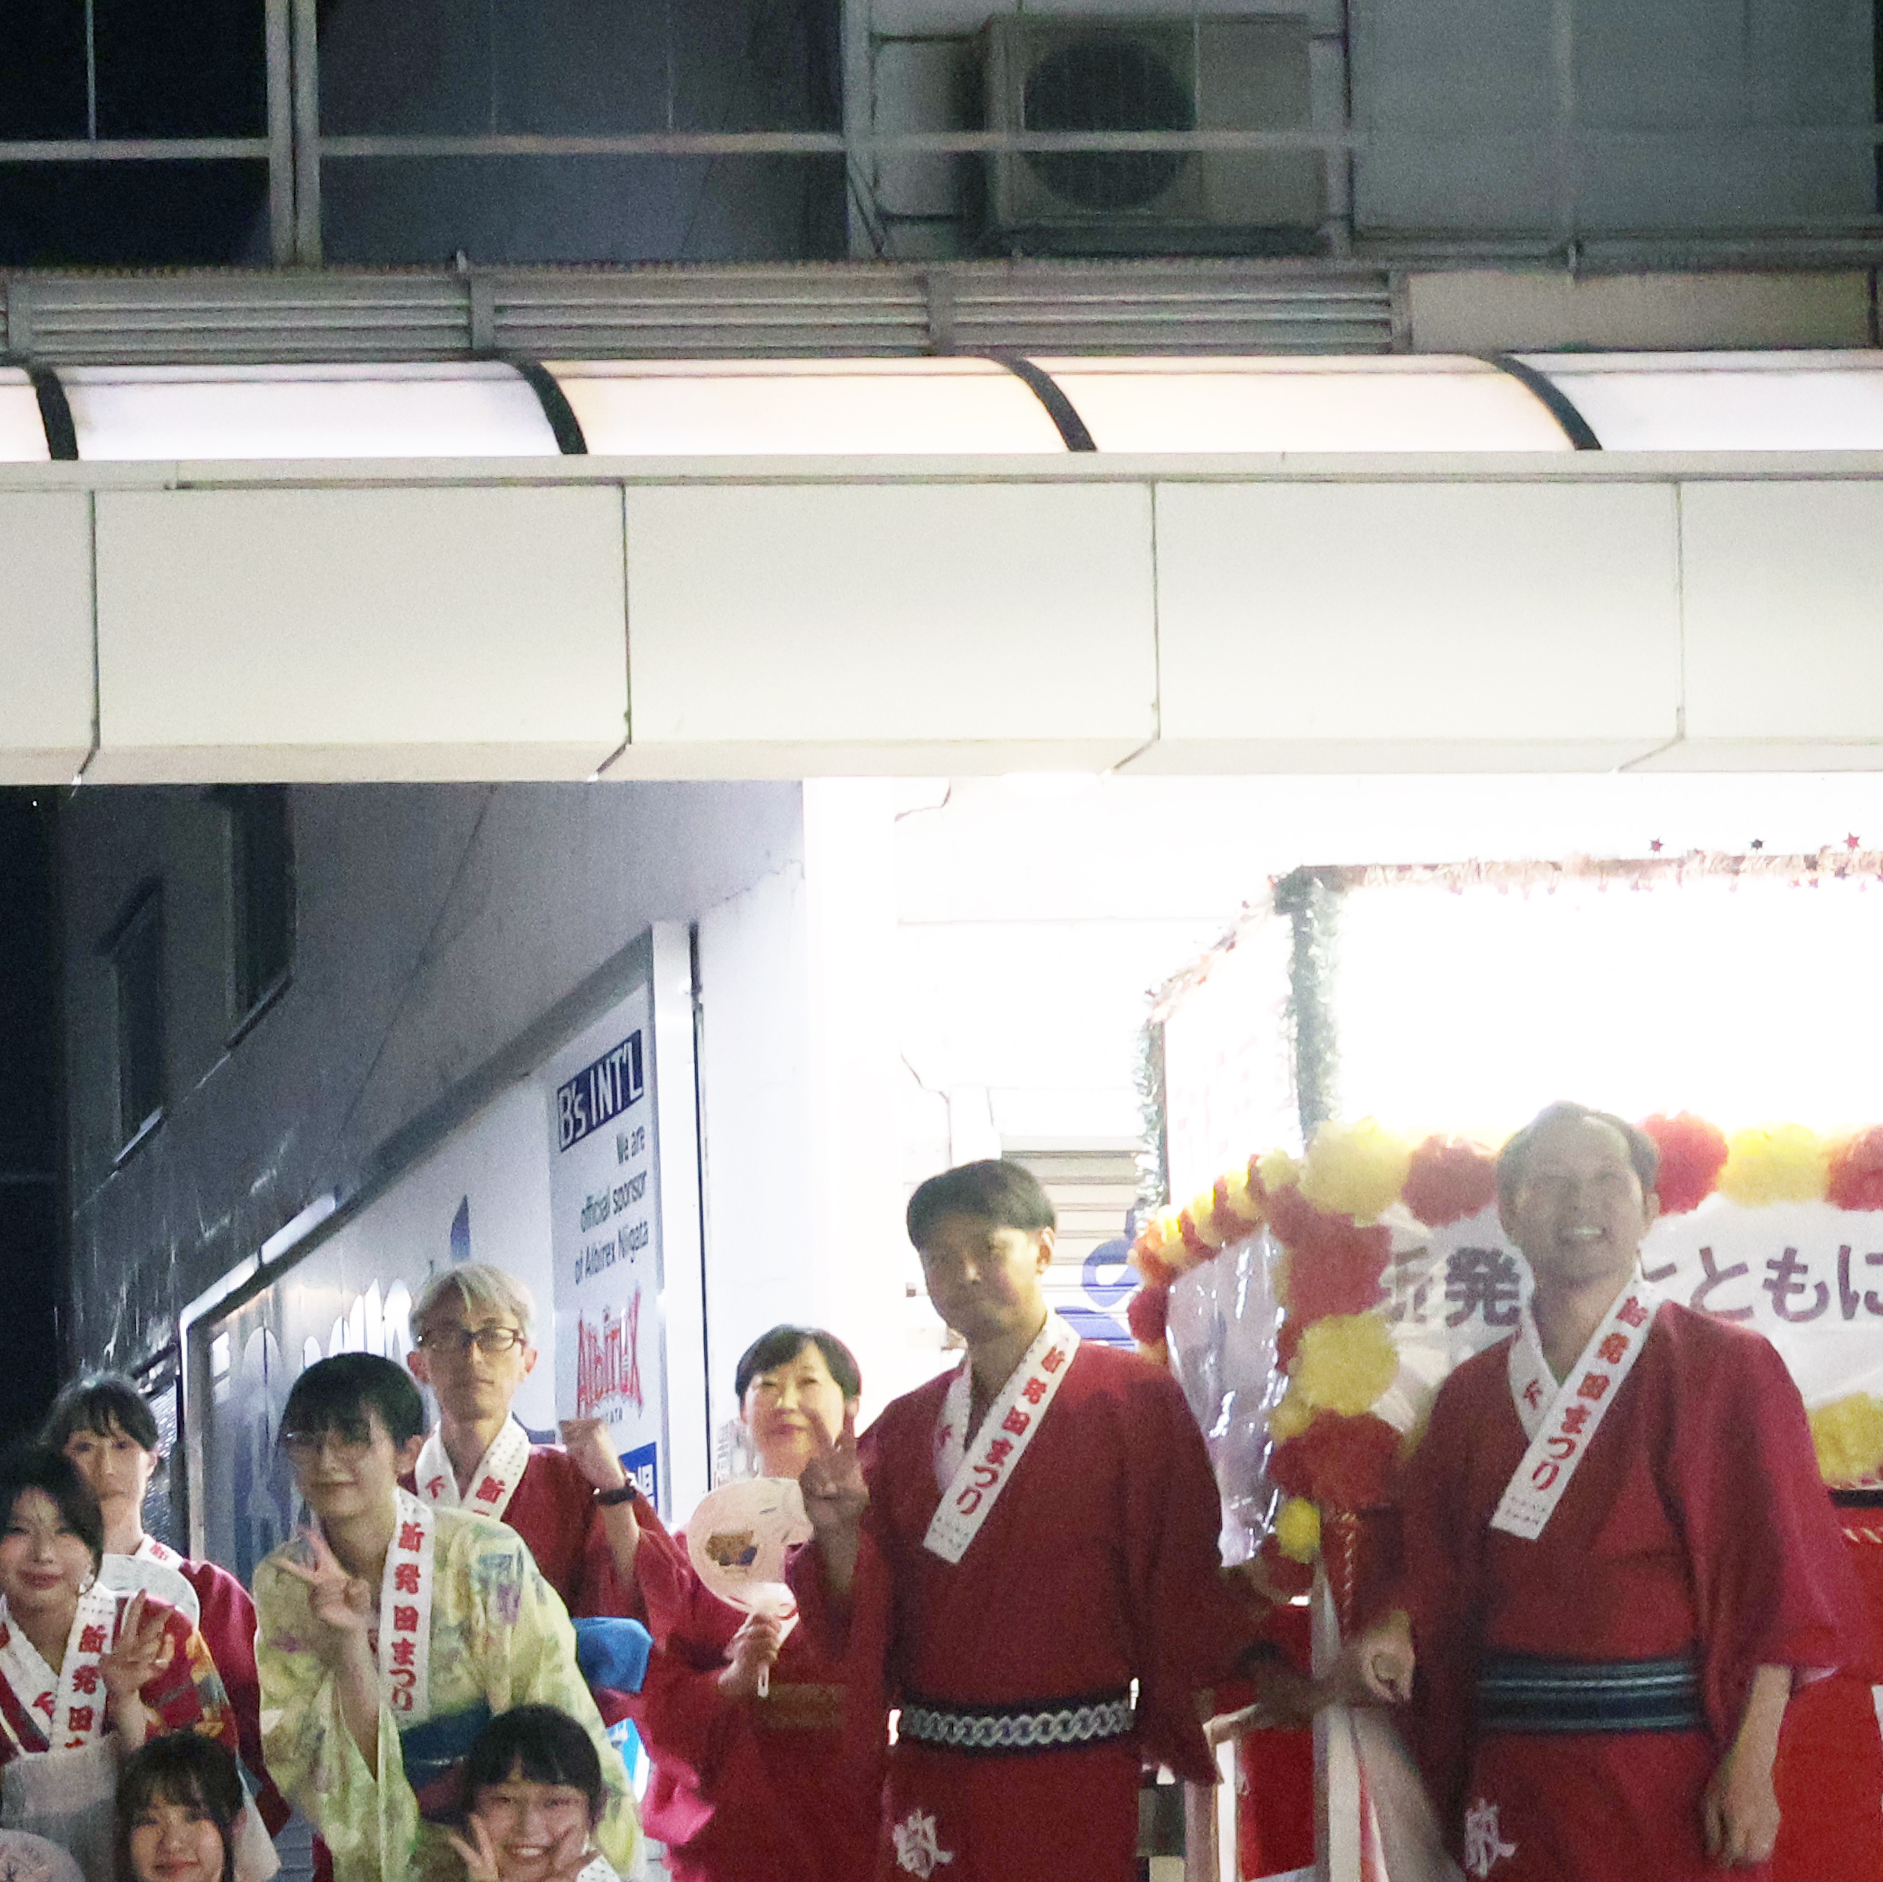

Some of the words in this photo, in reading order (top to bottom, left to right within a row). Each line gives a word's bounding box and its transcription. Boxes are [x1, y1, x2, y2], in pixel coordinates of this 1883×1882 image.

[558, 1080, 586, 1150] B's
[590, 1041, 643, 1126] INT'L
[956, 1346, 1065, 1515] 新発田まつり
[1532, 1296, 1648, 1491] 新発田まつり
[473, 1475, 506, 1516] 新
[388, 1521, 426, 1712] 新発田まつり
